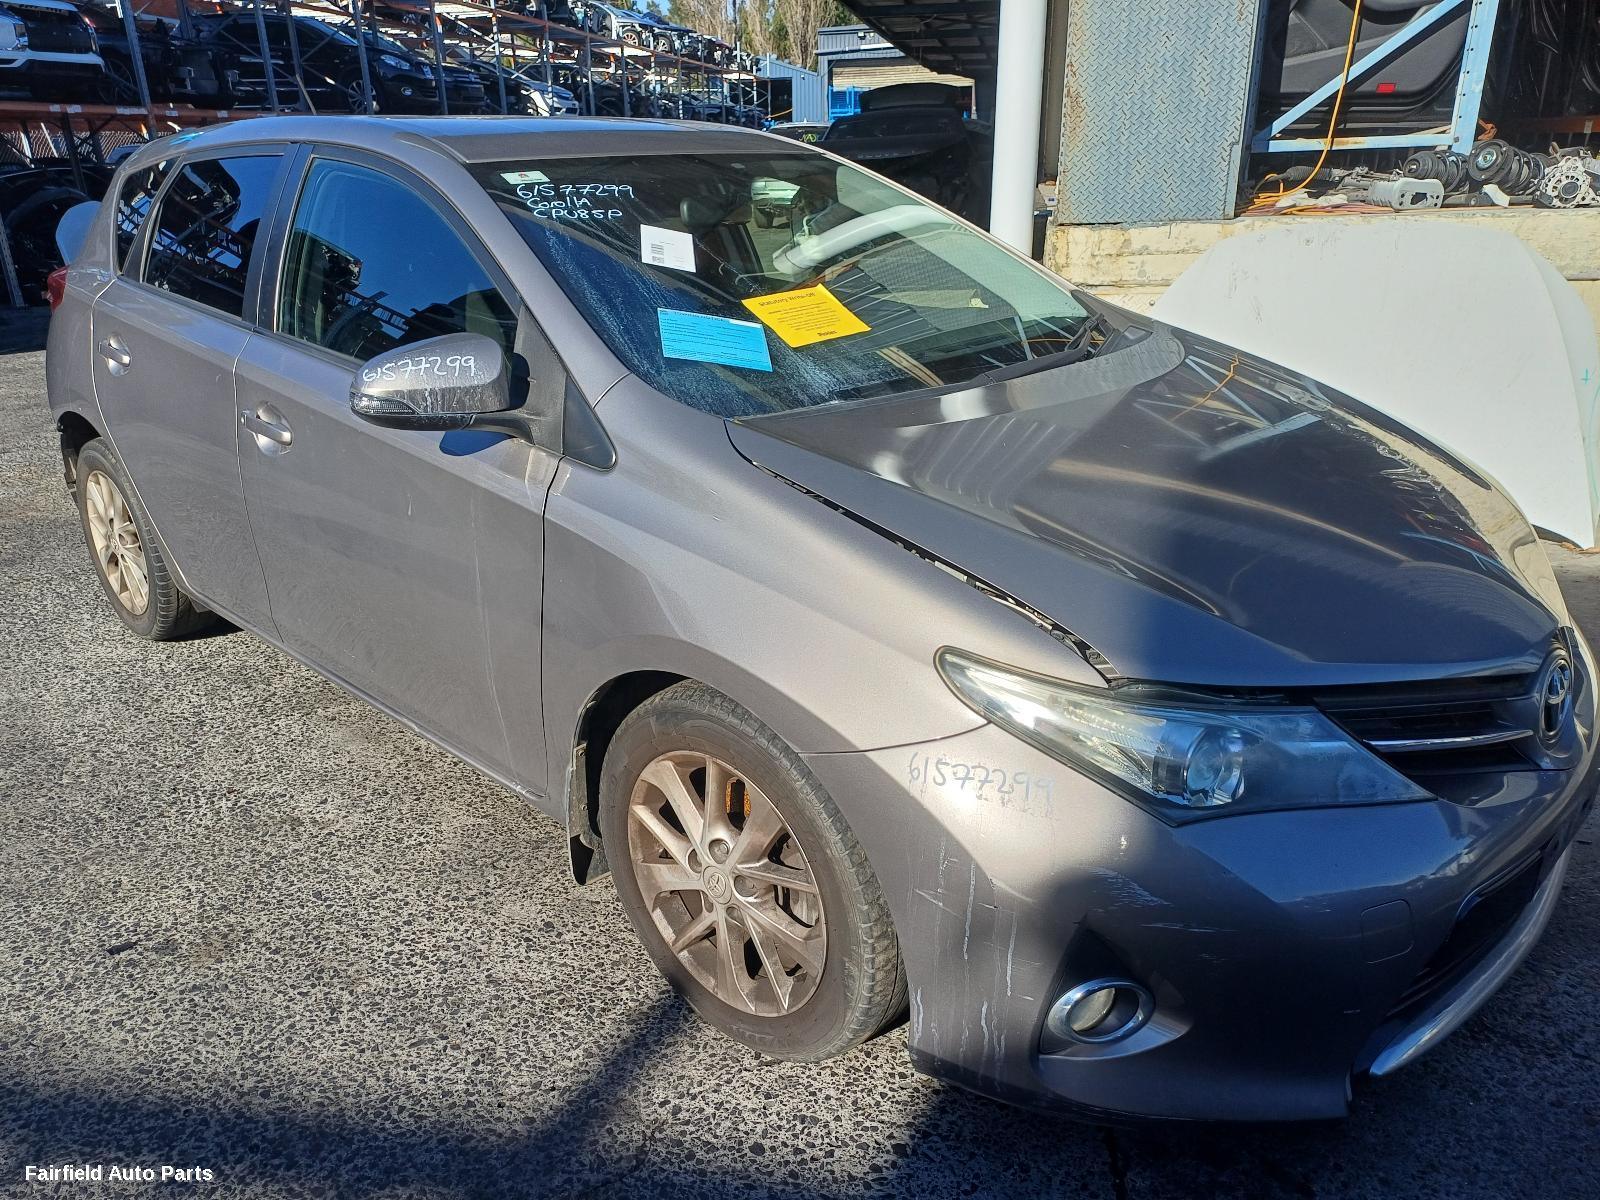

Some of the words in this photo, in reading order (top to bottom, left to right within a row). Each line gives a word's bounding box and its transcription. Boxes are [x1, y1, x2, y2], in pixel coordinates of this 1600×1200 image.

[516, 183, 635, 199] 61577299
[362, 355, 476, 382] 61577299
[909, 752, 1056, 814] 61577299
